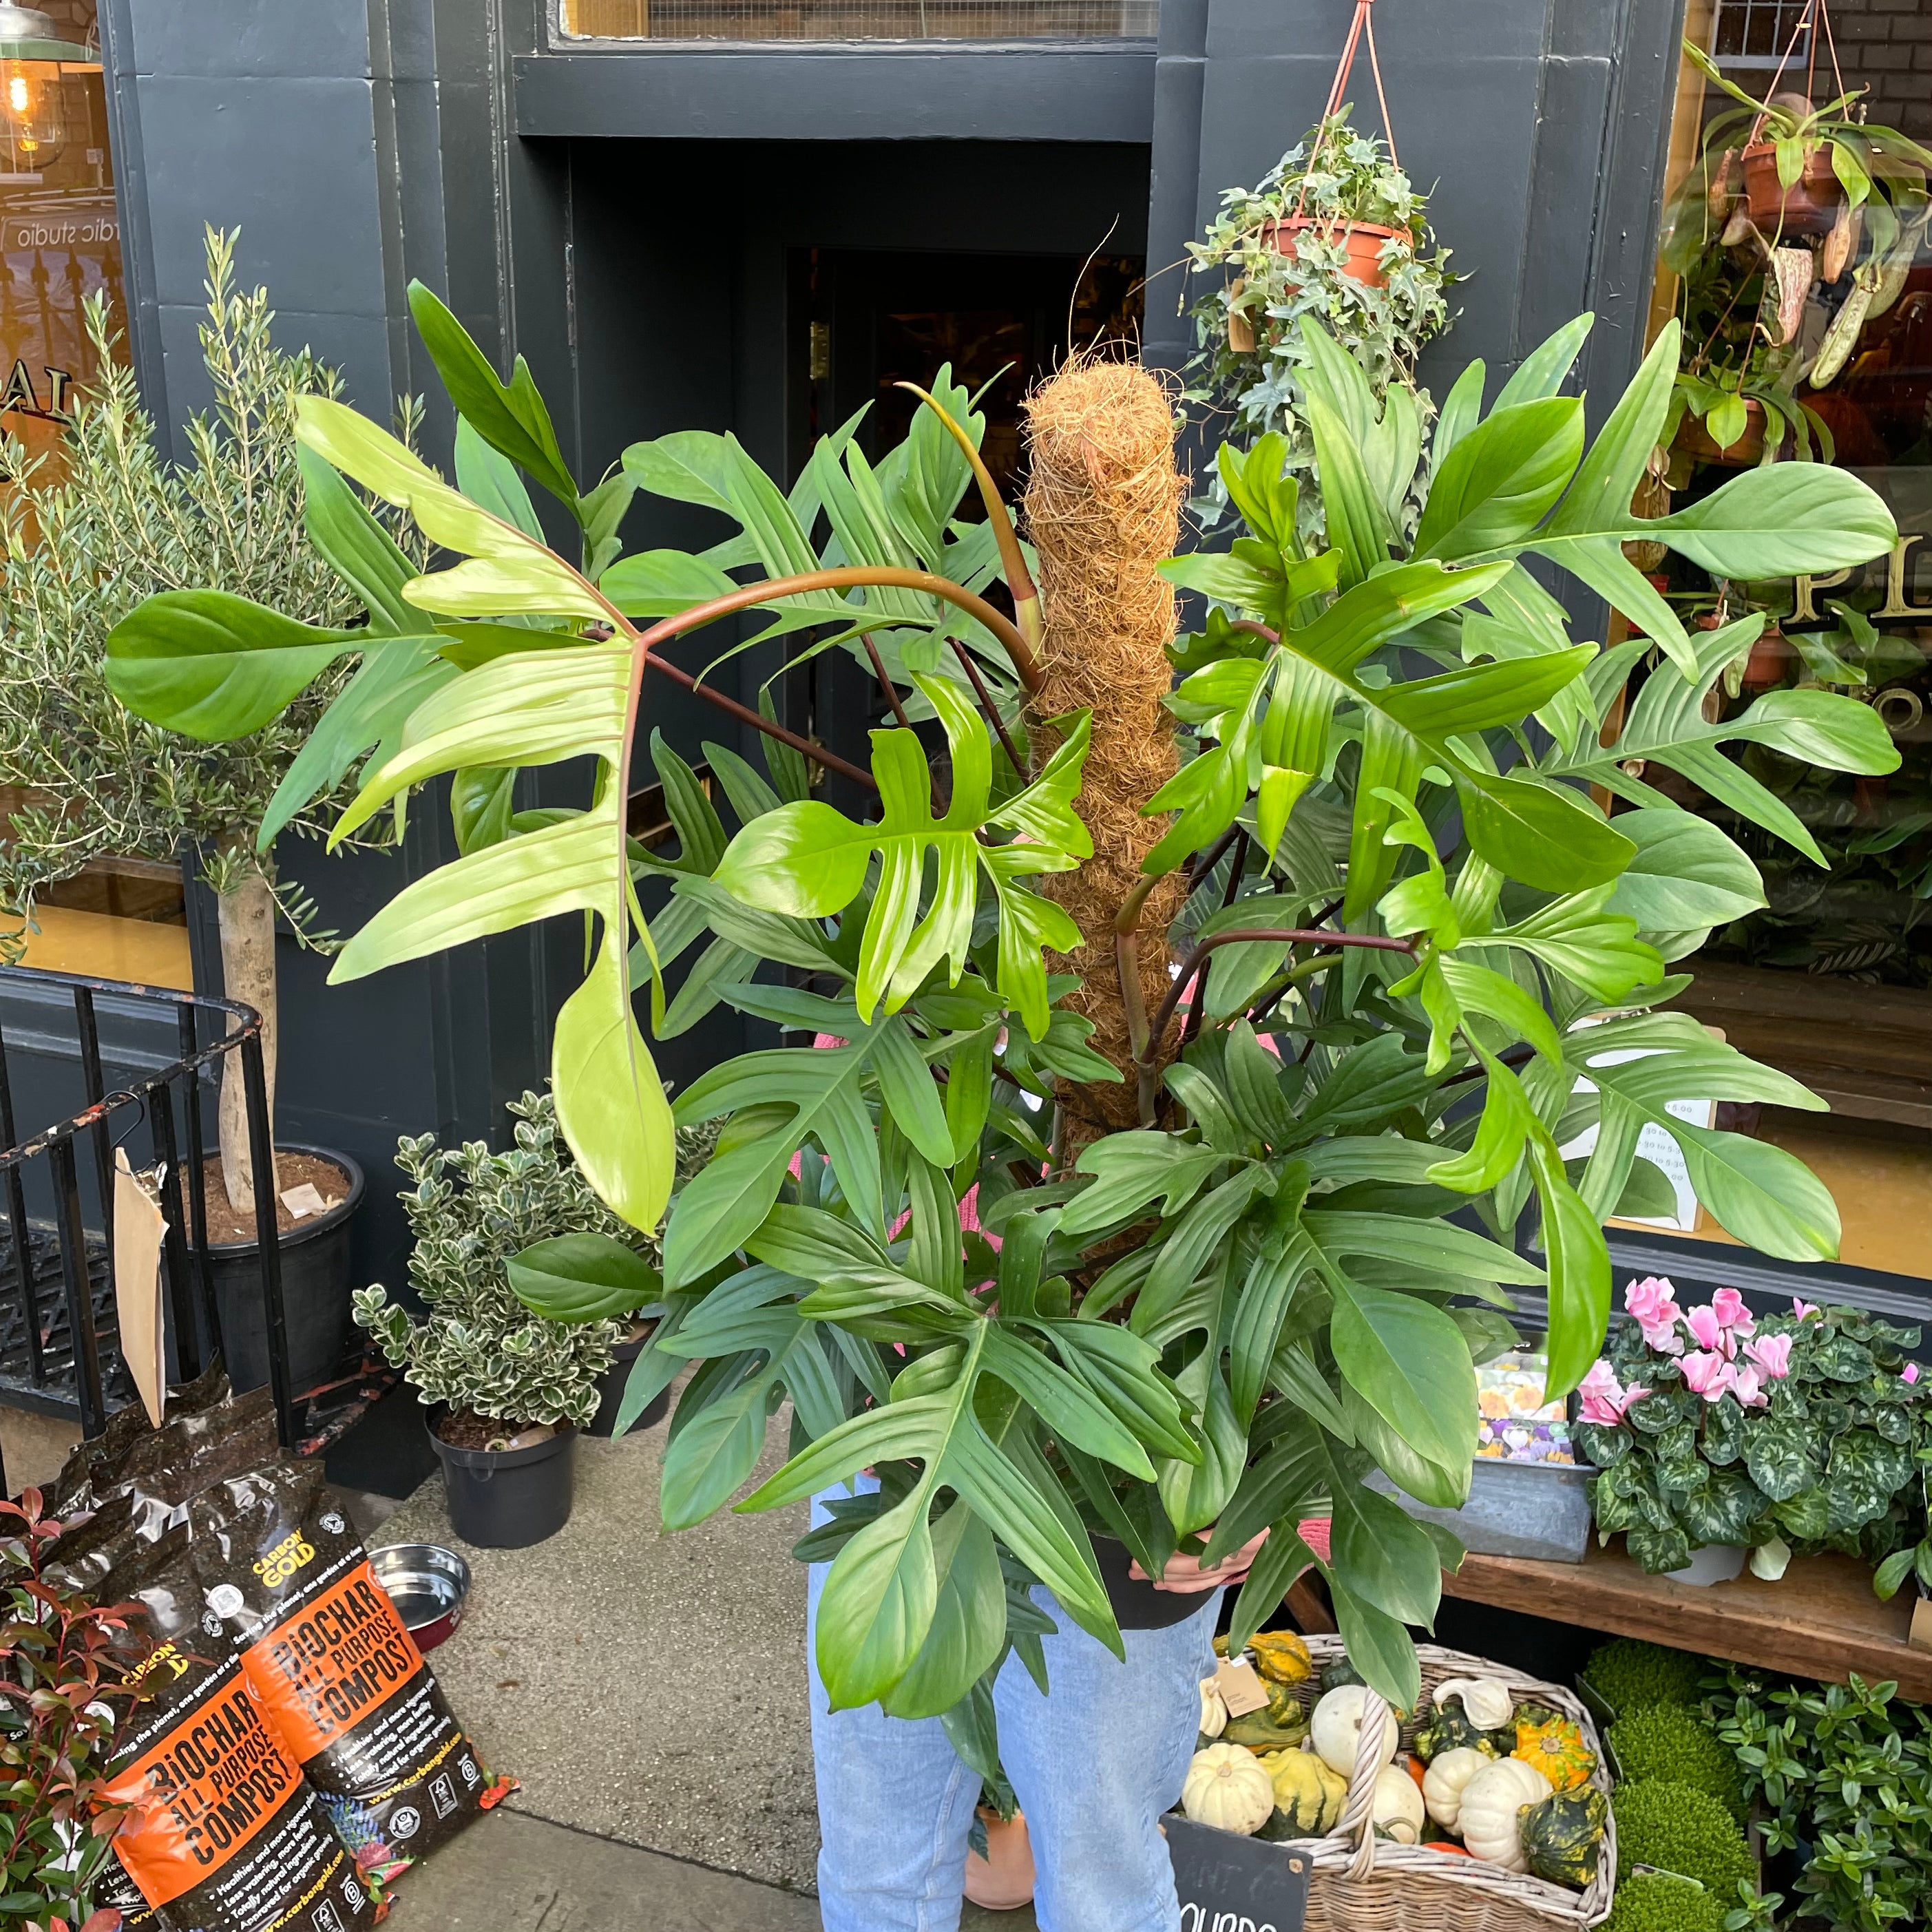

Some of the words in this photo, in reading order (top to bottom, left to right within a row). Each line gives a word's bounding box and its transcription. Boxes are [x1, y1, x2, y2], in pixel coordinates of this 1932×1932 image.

[253, 1528, 304, 1575] CARBON
[262, 1542, 315, 1588] GOLD
[233, 1621, 264, 1644] Saving
[262, 1610, 277, 1624] the
[276, 1590, 305, 1615] planet,
[303, 1580, 317, 1593] one
[316, 1564, 339, 1584] garden
[337, 1557, 346, 1567] at
[330, 1610, 398, 1674] PURPOSE
[136, 1730, 152, 1744] the
[150, 1707, 180, 1733] planet,
[178, 1694, 194, 1708] one
[193, 1672, 218, 1698] garden
[216, 1665, 226, 1675] at
[293, 1665, 335, 1704] ALL
[307, 1632, 414, 1734] COMPOST
[209, 1724, 273, 1798] PURPOSE
[337, 1733, 373, 1763] Healthier
[373, 1718, 389, 1736] and
[388, 1706, 406, 1724] more
[351, 1762, 379, 1785] Totally
[379, 1739, 406, 1765] natural
[395, 1754, 410, 1766] for
[344, 1759, 364, 1775] Less
[170, 1788, 214, 1833] ALL
[185, 1748, 293, 1865] COMPOST
[107, 1872, 128, 1887] Less
[216, 1860, 255, 1896] Healthier
[254, 1844, 271, 1864] and
[269, 1829, 287, 1849] more
[223, 1889, 244, 1908] Less
[277, 1840, 296, 1860] more
[230, 1893, 262, 1920] Totally
[260, 1865, 288, 1896] natural
[240, 1890, 282, 1930] Approved
[279, 1881, 292, 1896] for
[292, 1856, 316, 1884] organic
